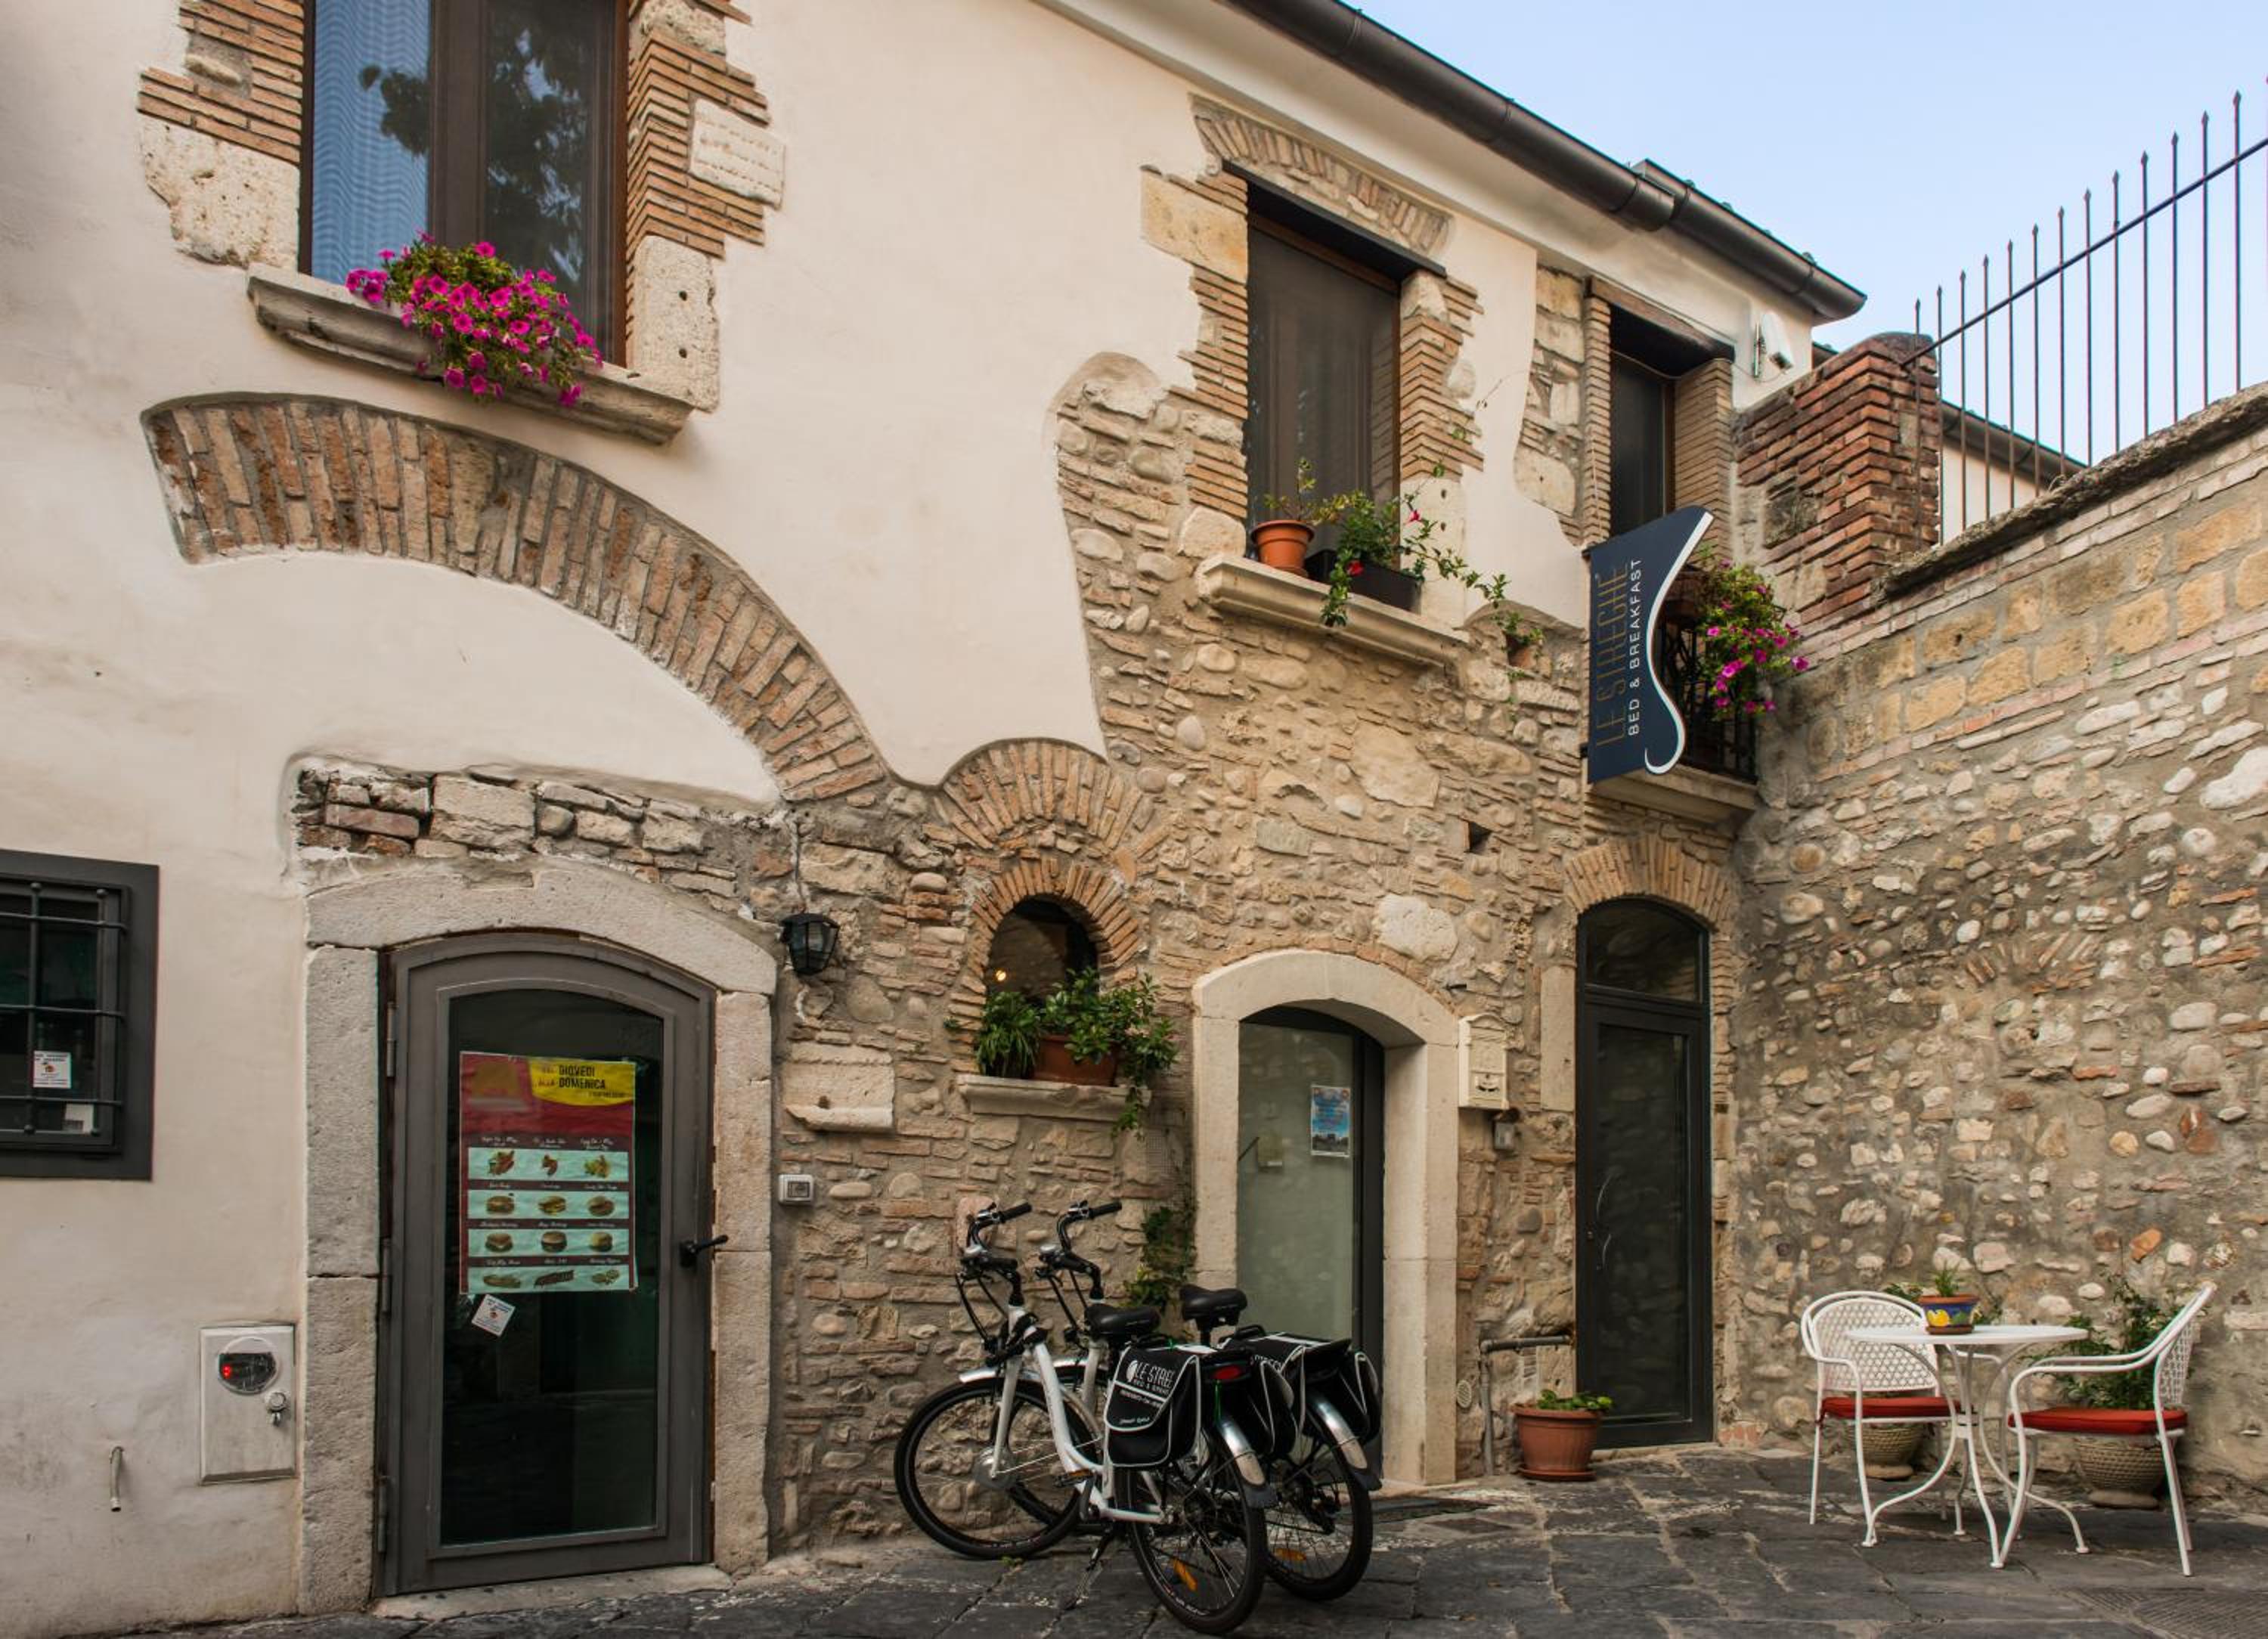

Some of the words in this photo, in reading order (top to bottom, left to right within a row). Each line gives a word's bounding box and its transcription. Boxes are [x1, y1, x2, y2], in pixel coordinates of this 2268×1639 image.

[1628, 559, 1641, 669] BREAKFAST
[1629, 677, 1640, 689] &
[1596, 706, 1626, 747] LE
[1628, 699, 1640, 736] BED
[559, 1077, 606, 1089] DOMENICA
